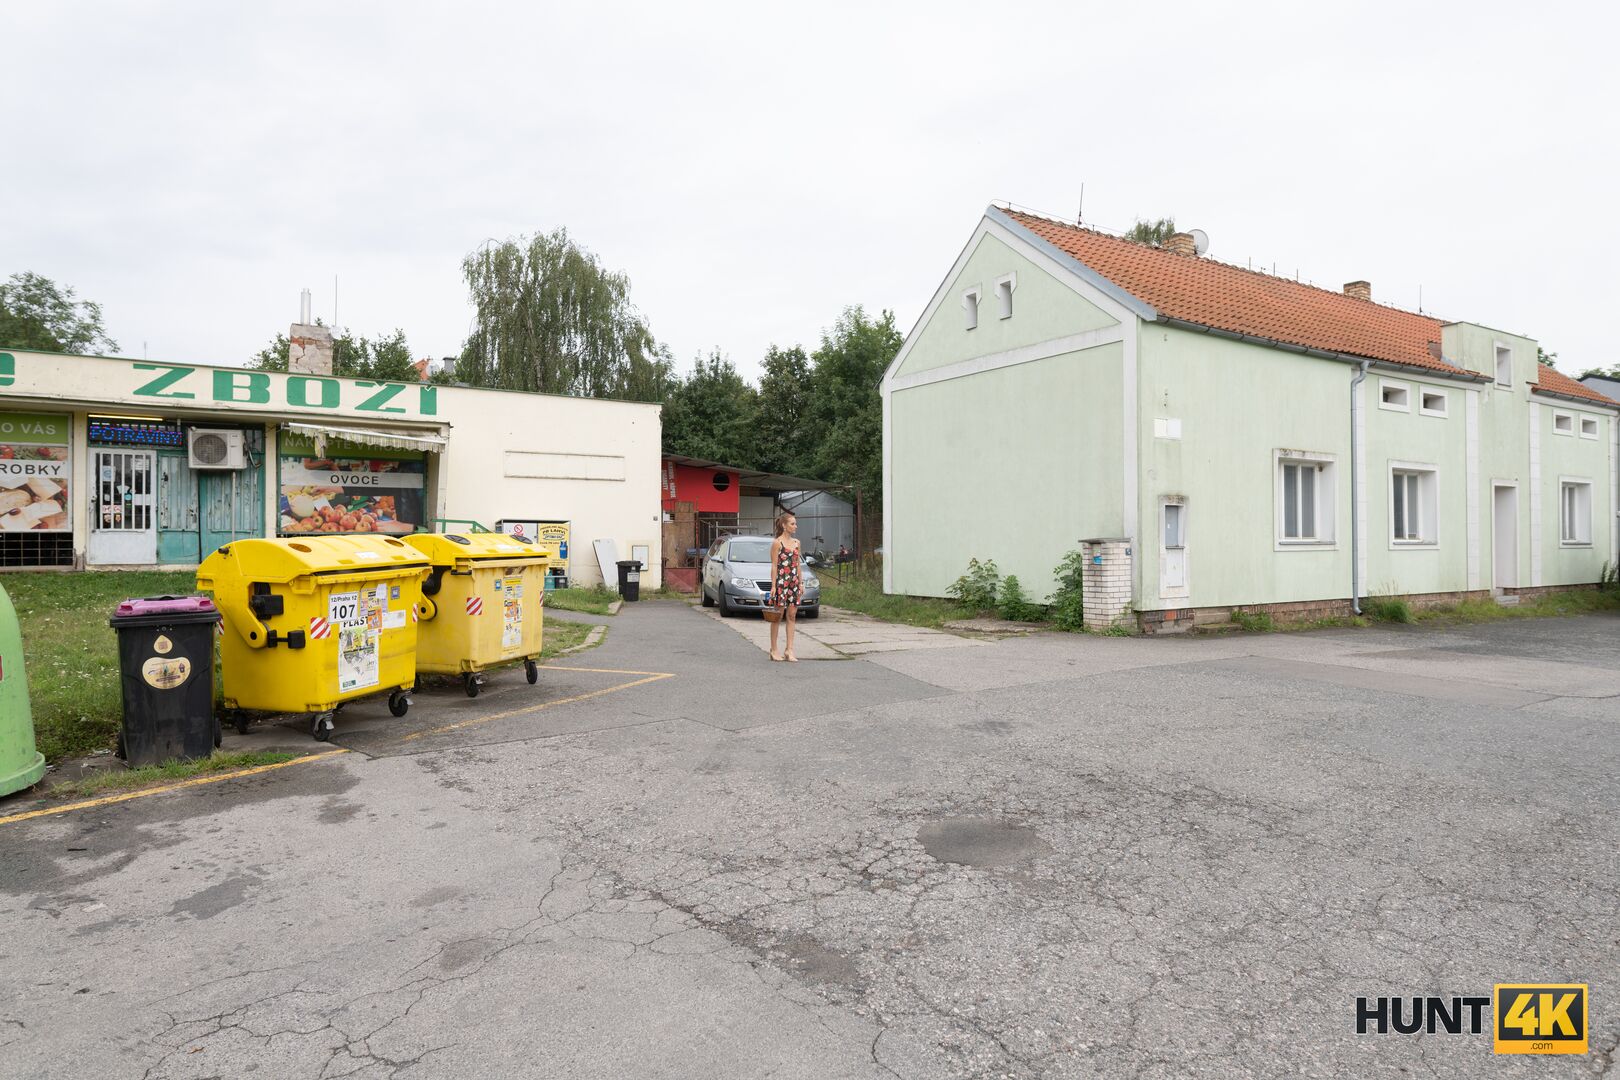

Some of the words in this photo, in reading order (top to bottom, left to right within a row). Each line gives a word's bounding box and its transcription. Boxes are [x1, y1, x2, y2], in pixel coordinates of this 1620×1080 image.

[20, 422, 56, 435] VÁS
[284, 437, 351, 450] NAKPTE
[330, 474, 380, 485] OVOCE
[332, 604, 356, 619] 107
